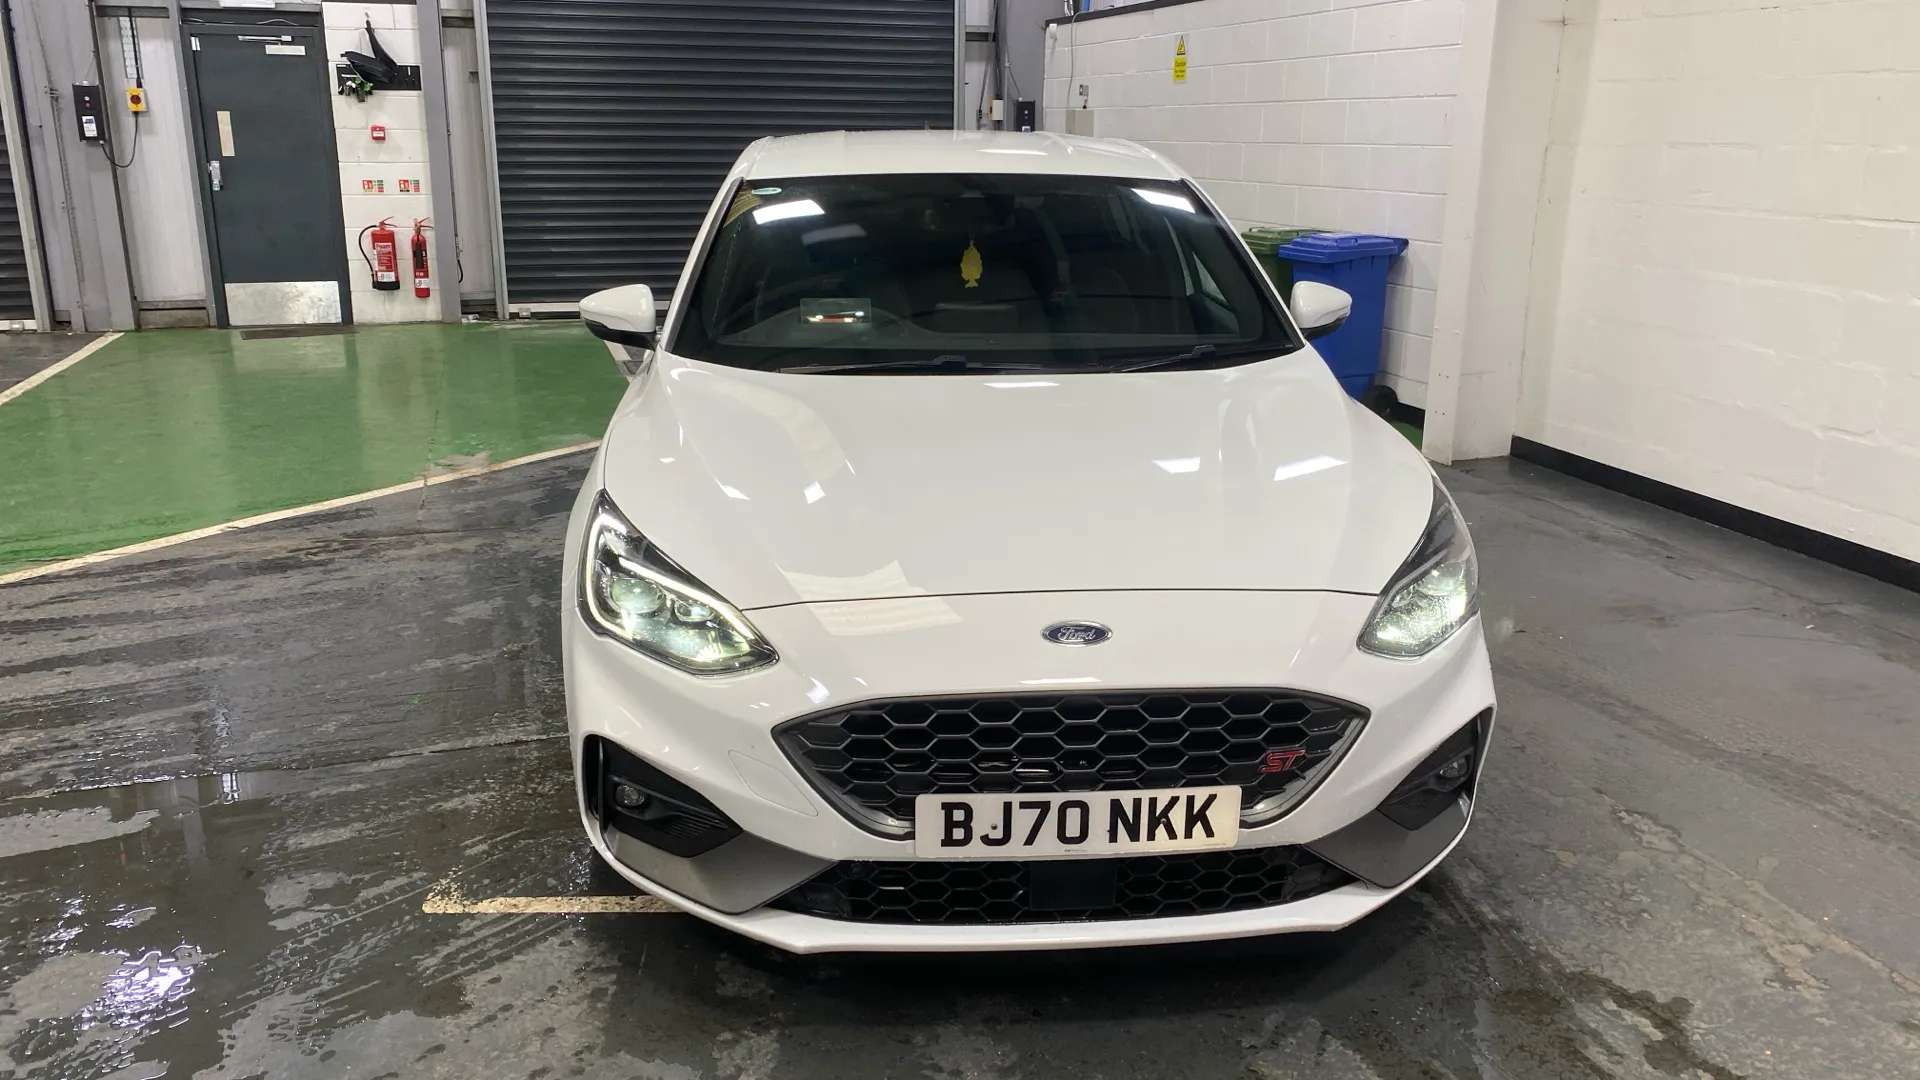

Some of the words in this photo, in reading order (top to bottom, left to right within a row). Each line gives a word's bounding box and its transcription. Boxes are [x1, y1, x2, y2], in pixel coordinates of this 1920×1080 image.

[1057, 626, 1096, 641] Ford
[1261, 750, 1306, 774] ST
[941, 800, 1089, 847] BJ70
[1109, 793, 1217, 843] NKK
